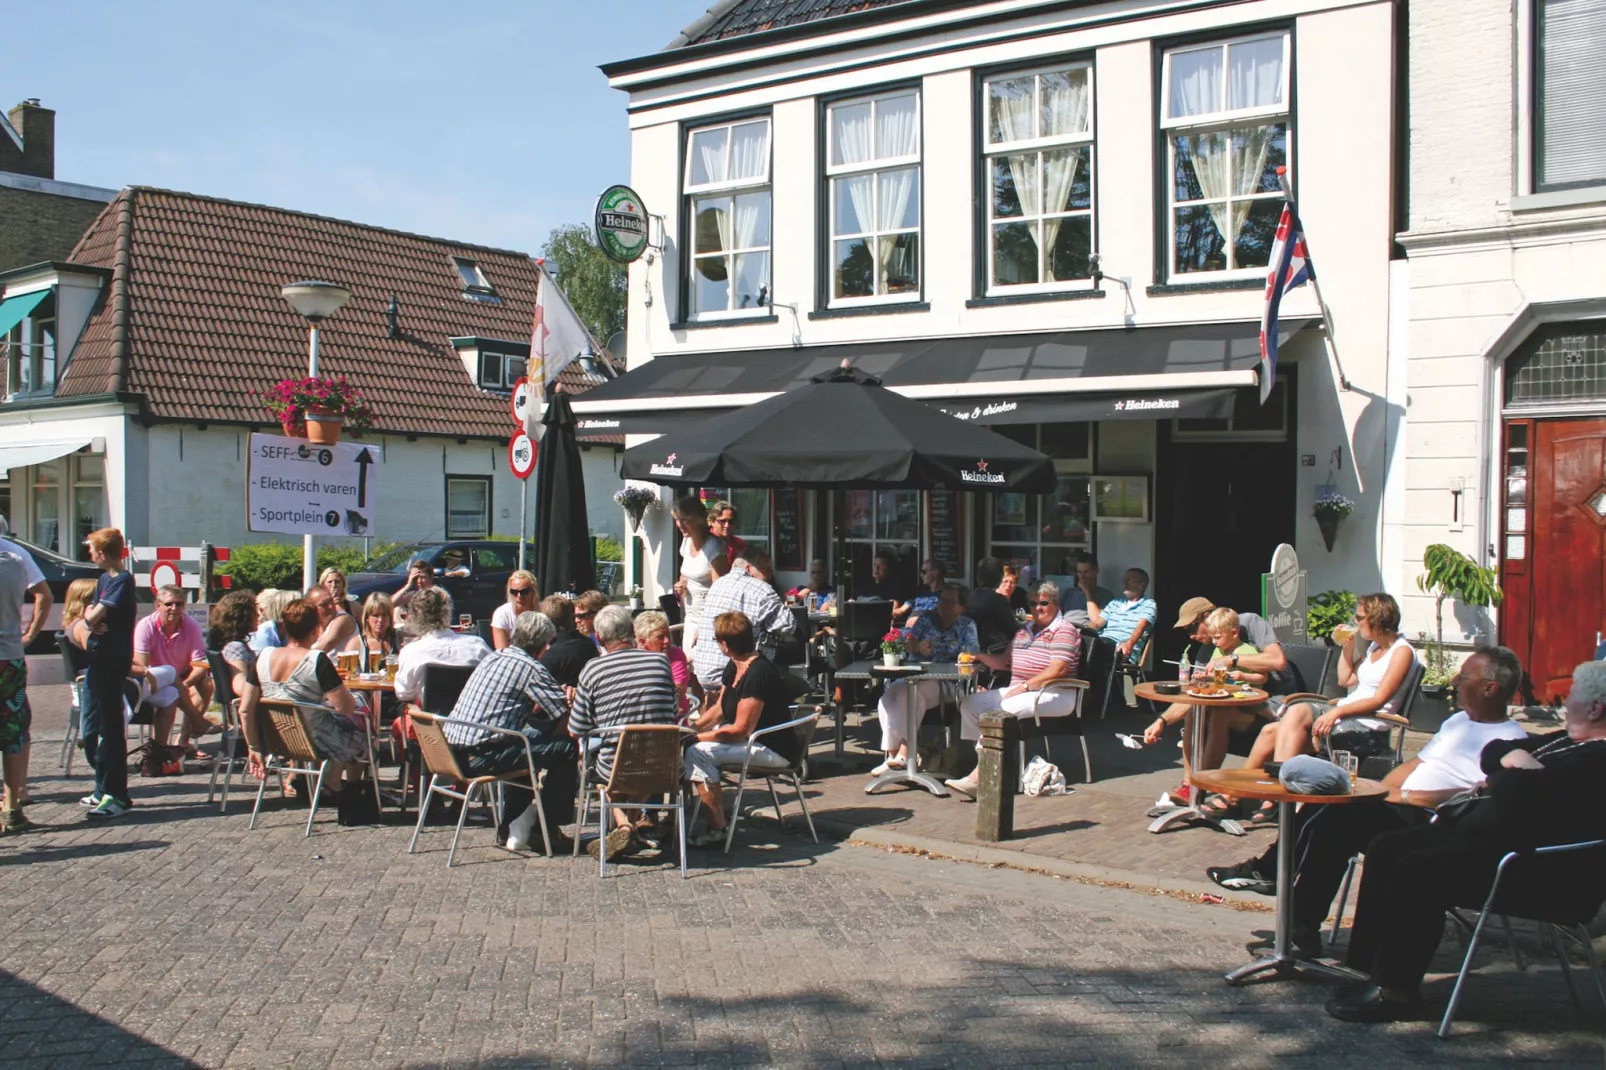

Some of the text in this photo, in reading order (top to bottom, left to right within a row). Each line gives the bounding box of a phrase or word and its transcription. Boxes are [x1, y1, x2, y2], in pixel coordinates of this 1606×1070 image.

[982, 401, 1017, 416] drinken
[1125, 399, 1179, 410] Heineken
[584, 420, 620, 428] Heineken
[261, 445, 290, 459] SEFF
[650, 464, 683, 476] Heineken
[961, 470, 1005, 482] Heineken
[260, 476, 357, 496] Elektrisch varen
[259, 507, 323, 524] Sportplein
